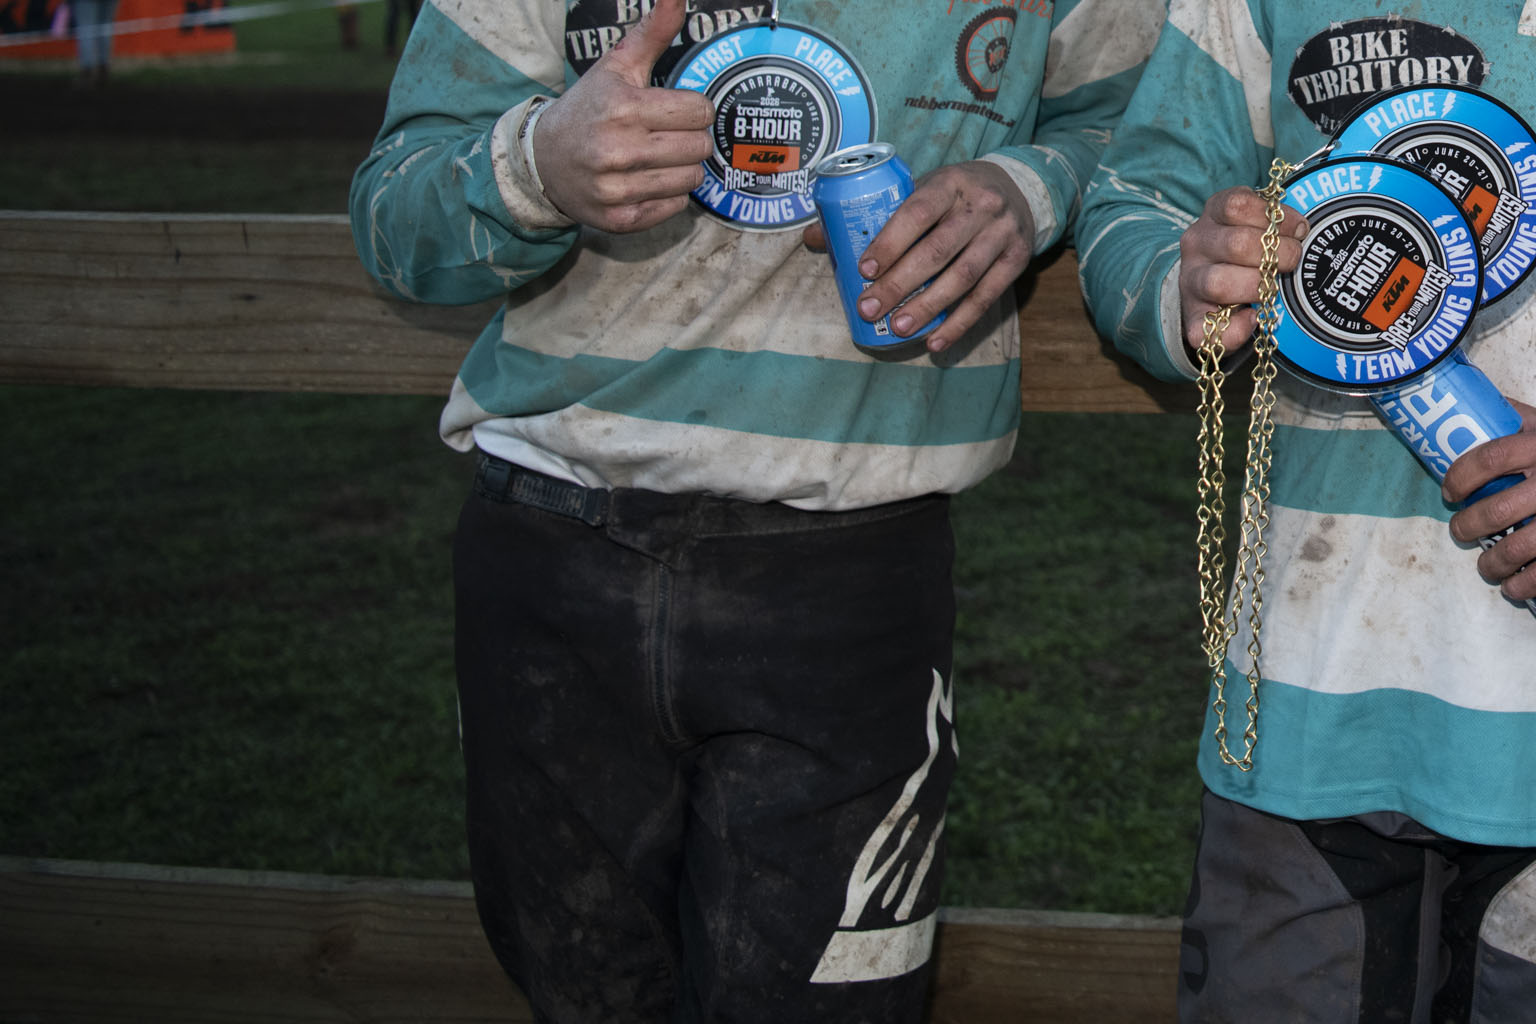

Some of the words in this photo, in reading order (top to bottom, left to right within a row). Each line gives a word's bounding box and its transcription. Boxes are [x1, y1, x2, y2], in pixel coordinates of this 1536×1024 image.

[566, 5, 765, 60] TERORY
[1329, 28, 1409, 66] BIKE
[692, 36, 744, 81] FIRST
[795, 36, 853, 87] PLACE
[1294, 55, 1475, 105] TERRITORY
[740, 75, 802, 96] NARRABRI
[734, 117, 802, 141] 8-HOUR
[736, 104, 803, 118] transmoto
[805, 101, 820, 122] JUNE
[1364, 92, 1436, 137] PLACE
[724, 165, 756, 192] RACE
[756, 175, 772, 185] YOUR
[771, 168, 810, 195] MATES!
[749, 151, 786, 164] KTM
[1434, 147, 1460, 159] JUNE
[1463, 154, 1489, 182] 20-21
[694, 175, 729, 209] AM
[729, 193, 795, 224] YOUNG
[1291, 165, 1363, 211] PLACE
[1480, 228, 1498, 246] YOUR
[1492, 189, 1529, 235] MATES!
[1303, 221, 1349, 279] NARRABRI
[1361, 219, 1388, 232] JUNE
[1390, 227, 1417, 254] 20-21
[1323, 234, 1375, 298] transmoto
[1330, 248, 1348, 271] 2026
[1441, 226, 1476, 288] GUNS
[1336, 241, 1397, 313] 8-HOUR
[1381, 274, 1410, 313] KTM
[1324, 309, 1345, 326] SOUTH
[1380, 309, 1418, 352] RACE
[1407, 295, 1425, 317] YOUR
[1419, 260, 1456, 308] MATES!
[1413, 295, 1473, 360] YOUNG
[1353, 351, 1417, 380] TEAM
[1376, 400, 1452, 478] CARLT
[1399, 370, 1492, 463] DR
